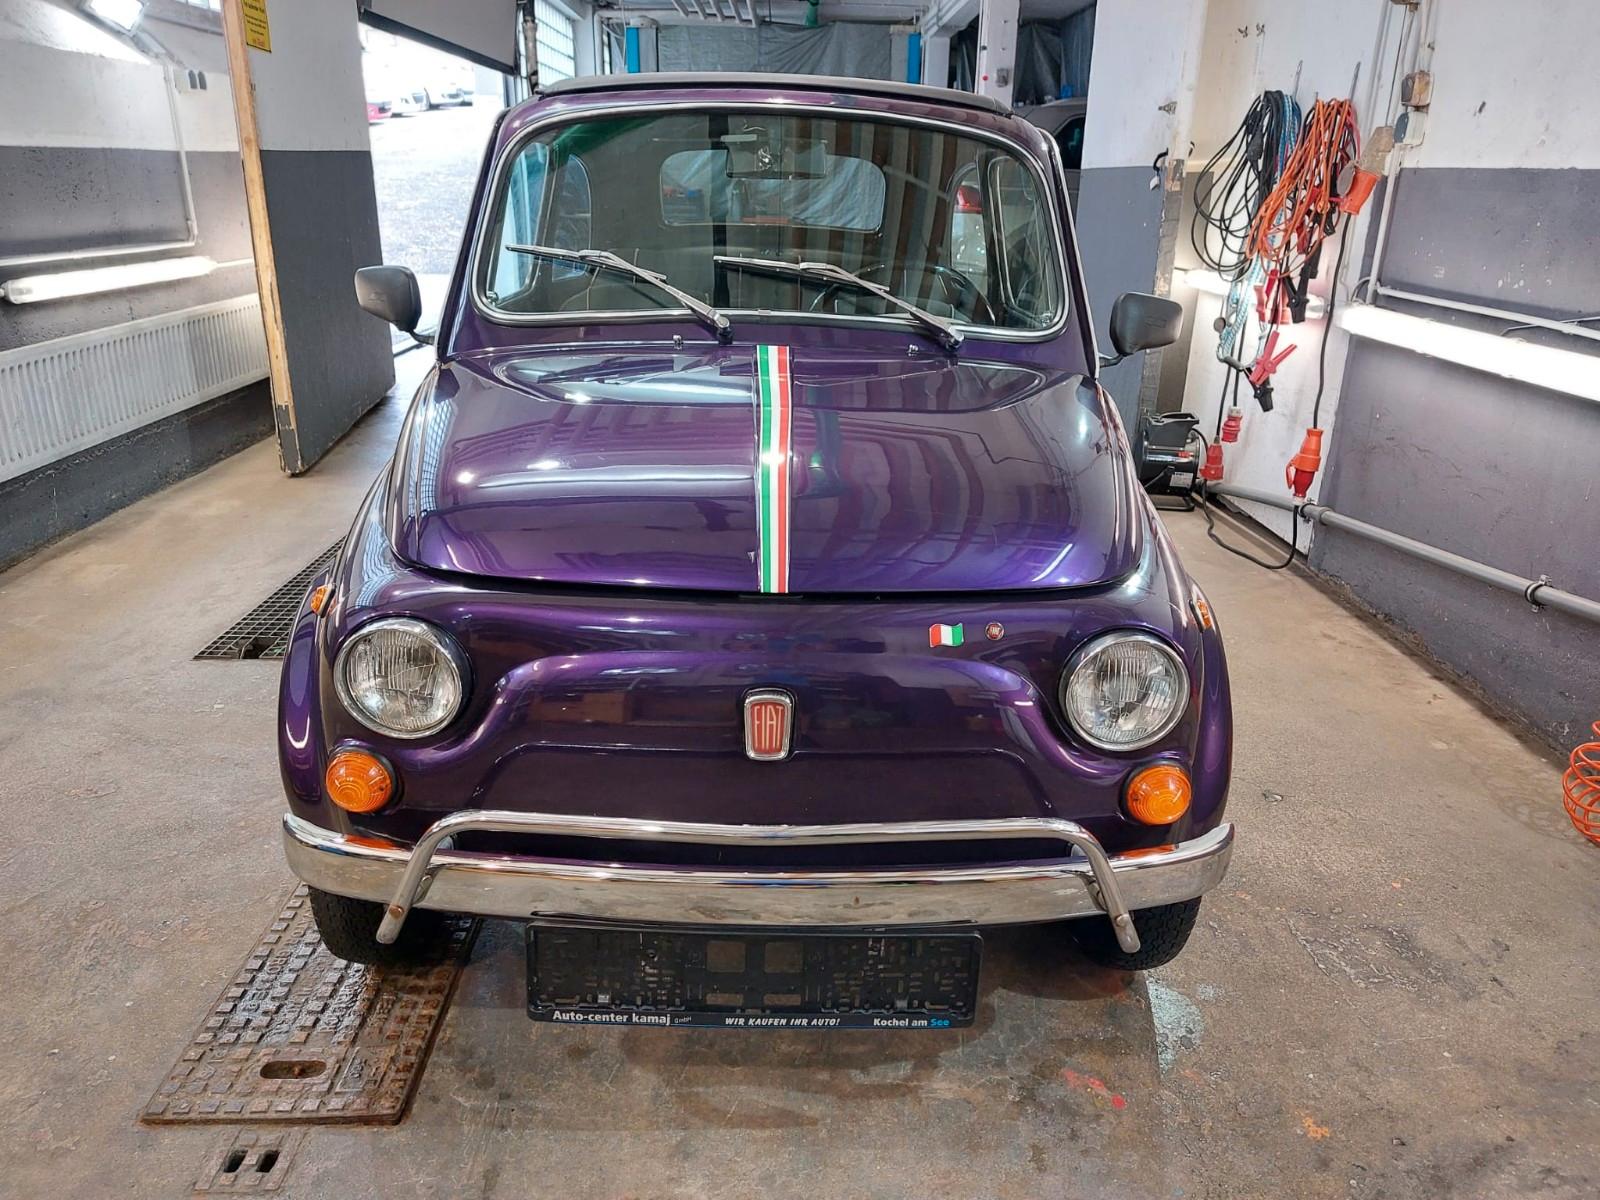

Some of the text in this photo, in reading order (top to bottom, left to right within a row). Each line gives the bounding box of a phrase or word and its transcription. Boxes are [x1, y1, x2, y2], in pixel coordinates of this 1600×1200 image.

[753, 704, 785, 750] FIAT
[552, 1010, 629, 1022] Auto-center
[632, 1012, 671, 1026] kamaj
[725, 1017, 840, 1026] WIR KAUFEN IHR AUTO!
[873, 1017, 950, 1027] Kochel am See
